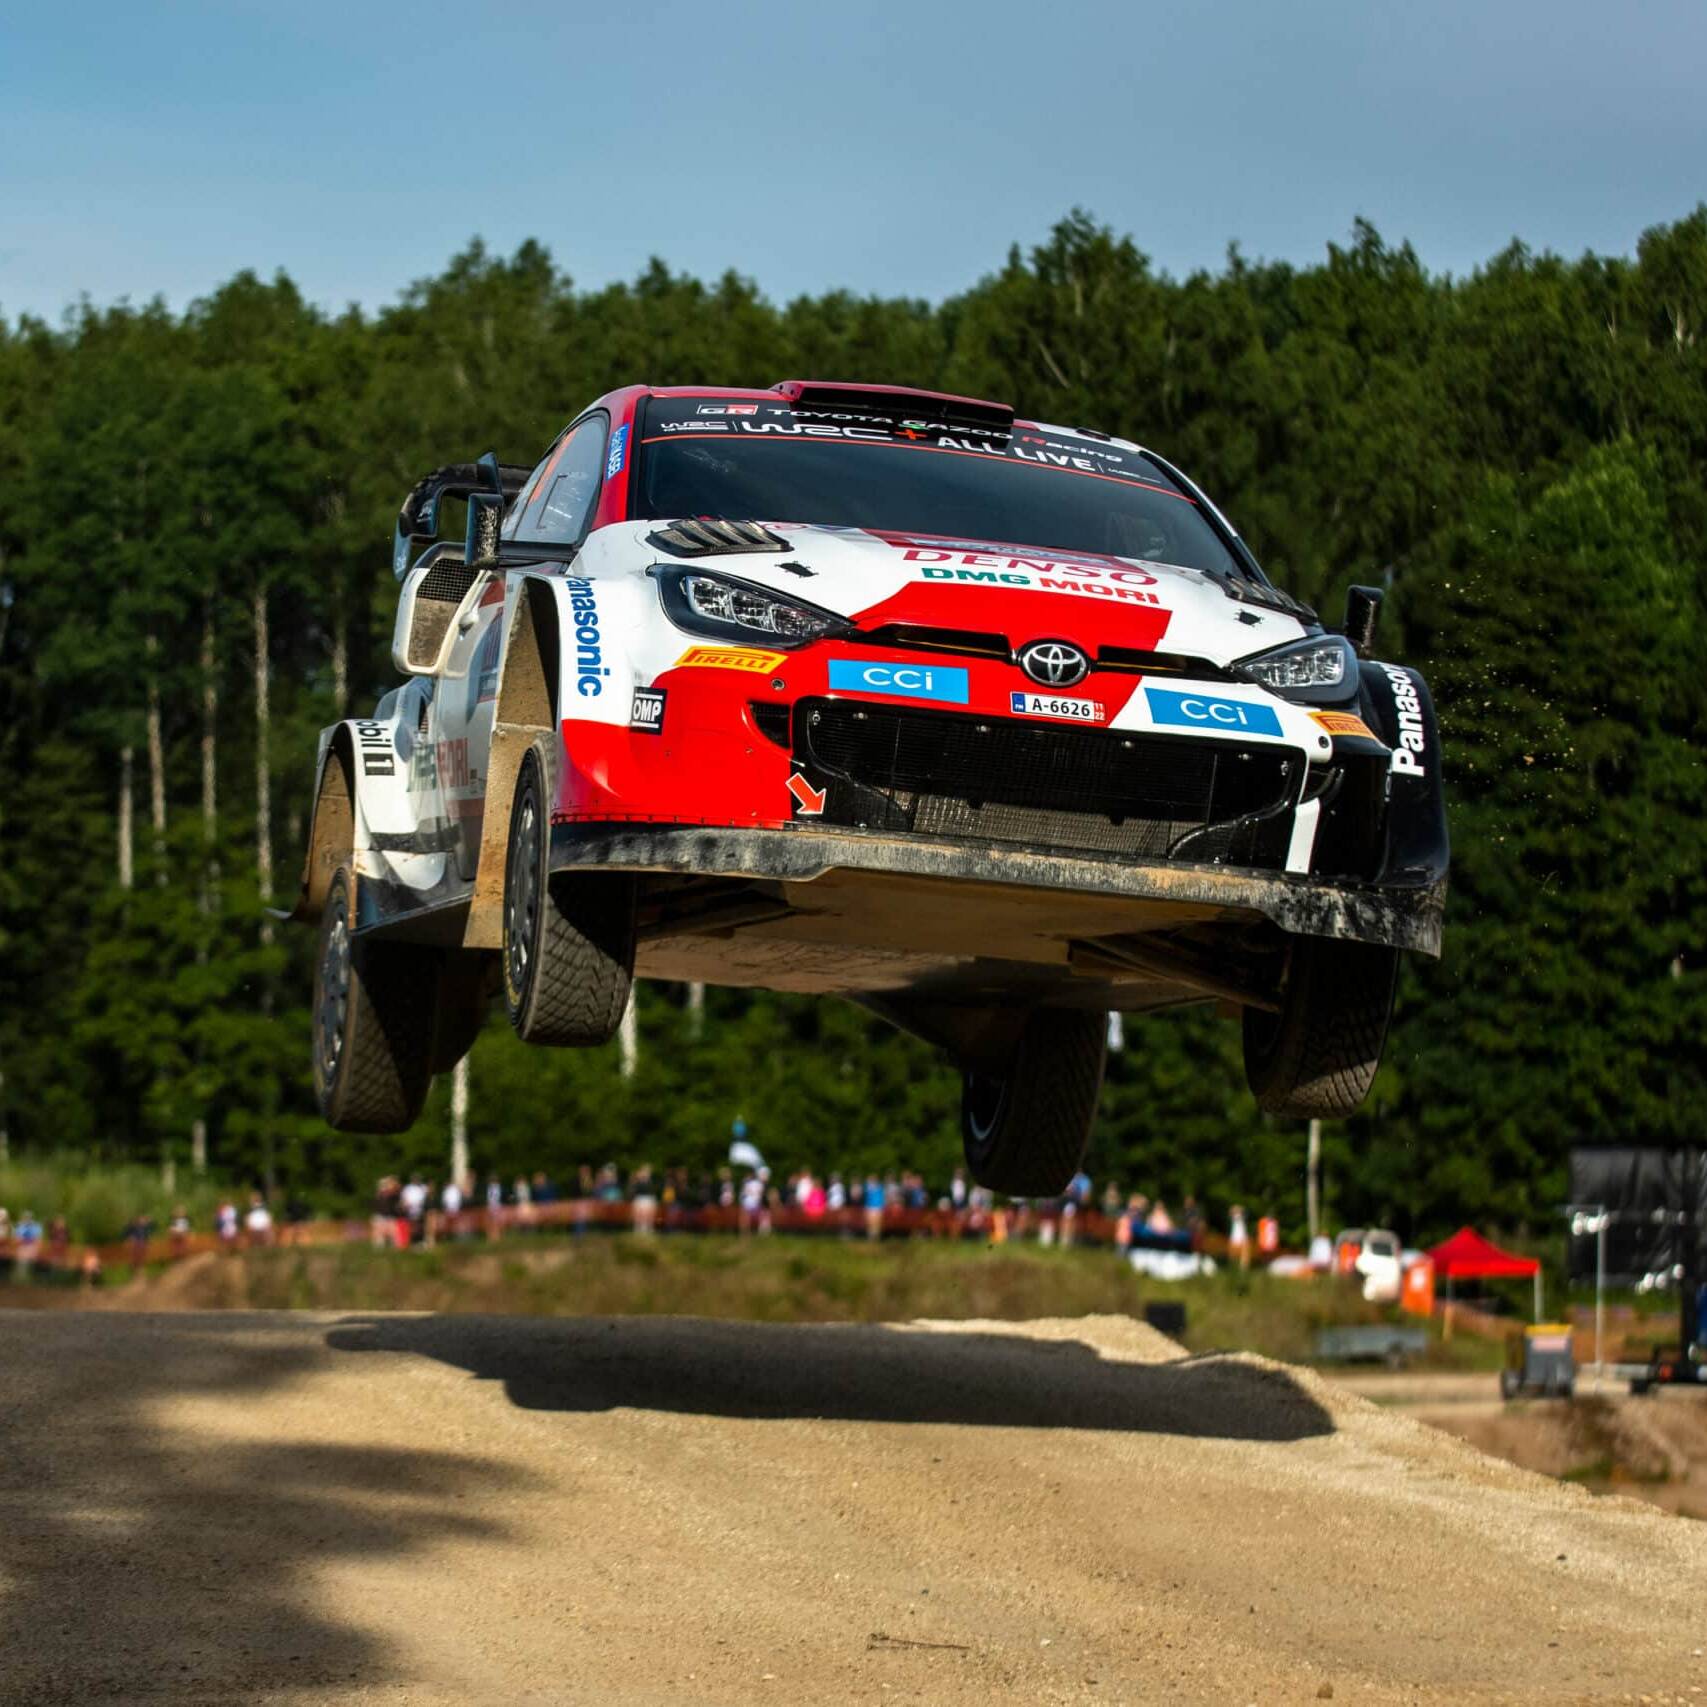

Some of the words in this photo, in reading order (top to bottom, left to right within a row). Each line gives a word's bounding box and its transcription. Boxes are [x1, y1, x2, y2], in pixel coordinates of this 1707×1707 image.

[766, 408, 893, 424] TOYOTA
[899, 419, 1014, 440] GAZOO
[1021, 436, 1122, 463] Racing
[937, 437, 1006, 455] ALL
[1014, 447, 1096, 472] LIVE
[903, 550, 1159, 586] DENSO
[921, 567, 1031, 585] DMG
[1039, 577, 1161, 605] MORI
[684, 650, 776, 669] PIRELLI
[633, 699, 662, 722] OMP
[1032, 698, 1091, 717] A-6626
[1095, 711, 1105, 720] 22
[356, 720, 393, 748] obil
